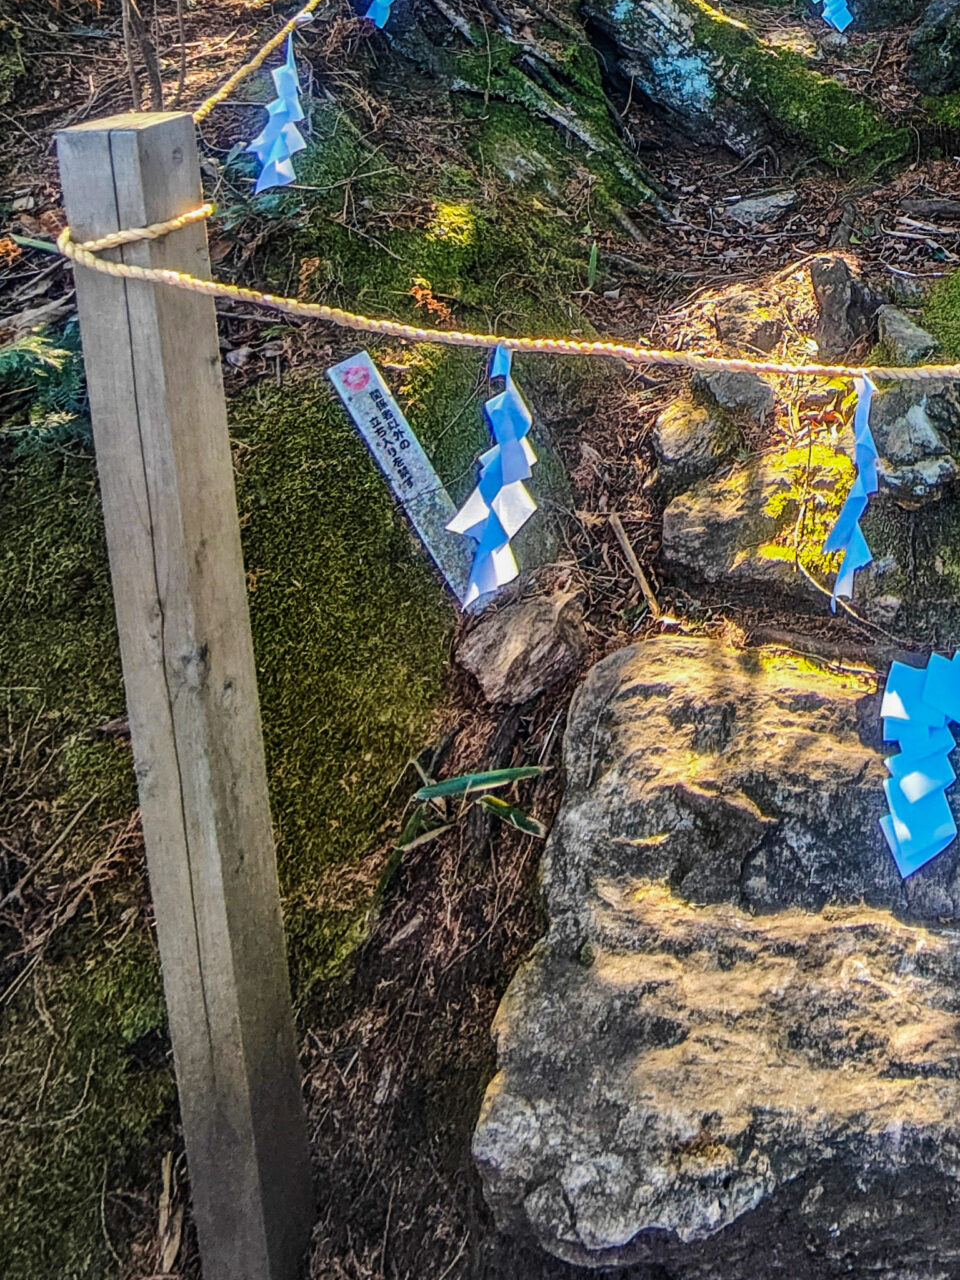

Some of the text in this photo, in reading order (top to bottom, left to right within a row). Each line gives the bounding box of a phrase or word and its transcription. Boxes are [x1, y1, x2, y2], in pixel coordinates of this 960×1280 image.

[369, 388, 411, 450] 関係者以外の
